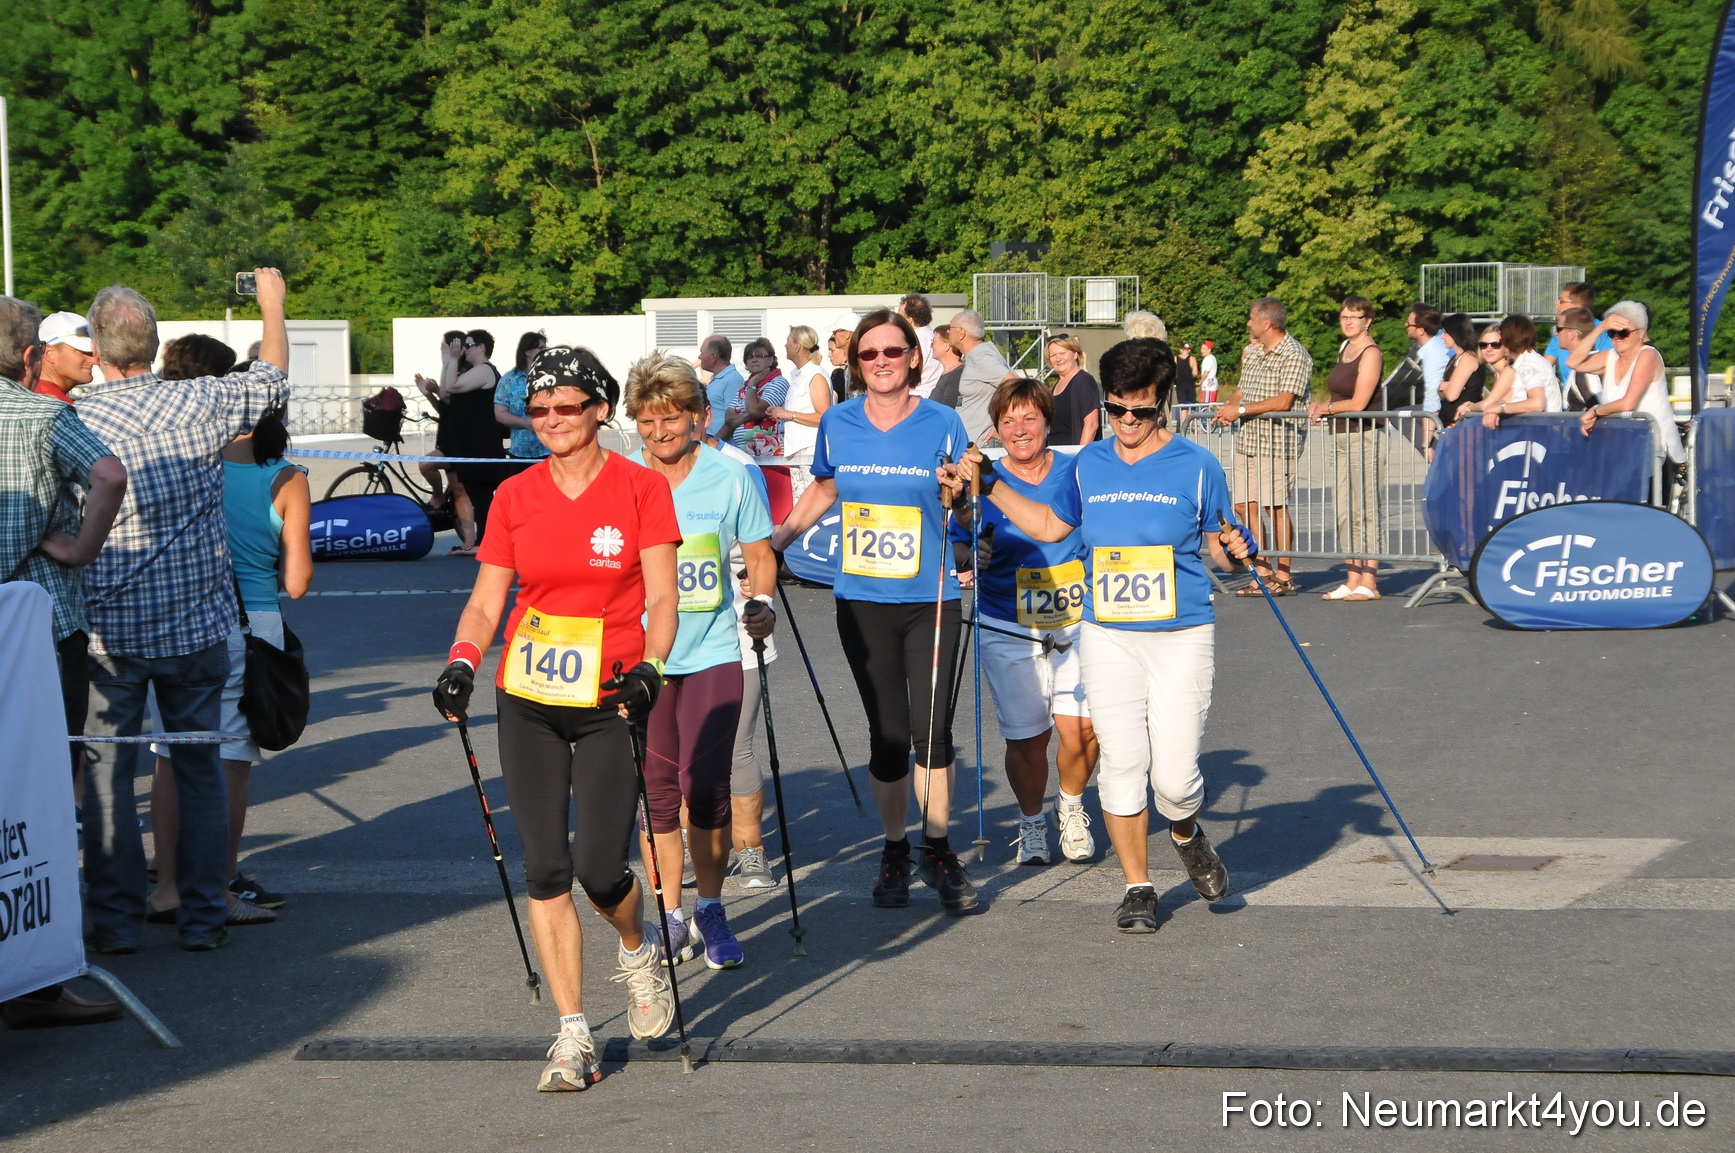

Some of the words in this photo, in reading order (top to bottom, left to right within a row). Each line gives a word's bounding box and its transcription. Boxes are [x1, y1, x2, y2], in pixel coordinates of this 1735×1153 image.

[838, 464, 930, 477] energiegeladen
[1088, 491, 1177, 505] energiegeladen
[695, 510, 724, 520] sumida
[310, 526, 411, 553] Fischer
[325, 543, 407, 557] AUTOMOBILE
[847, 528, 915, 561] 1263
[589, 558, 621, 569] caritas
[1535, 556, 1684, 588] Fischer
[1020, 584, 1084, 614] 1269
[1097, 572, 1166, 603] 1261
[1549, 586, 1673, 603] AUTOMOBILE
[520, 642, 582, 683] 140
[0, 817, 28, 864] ter
